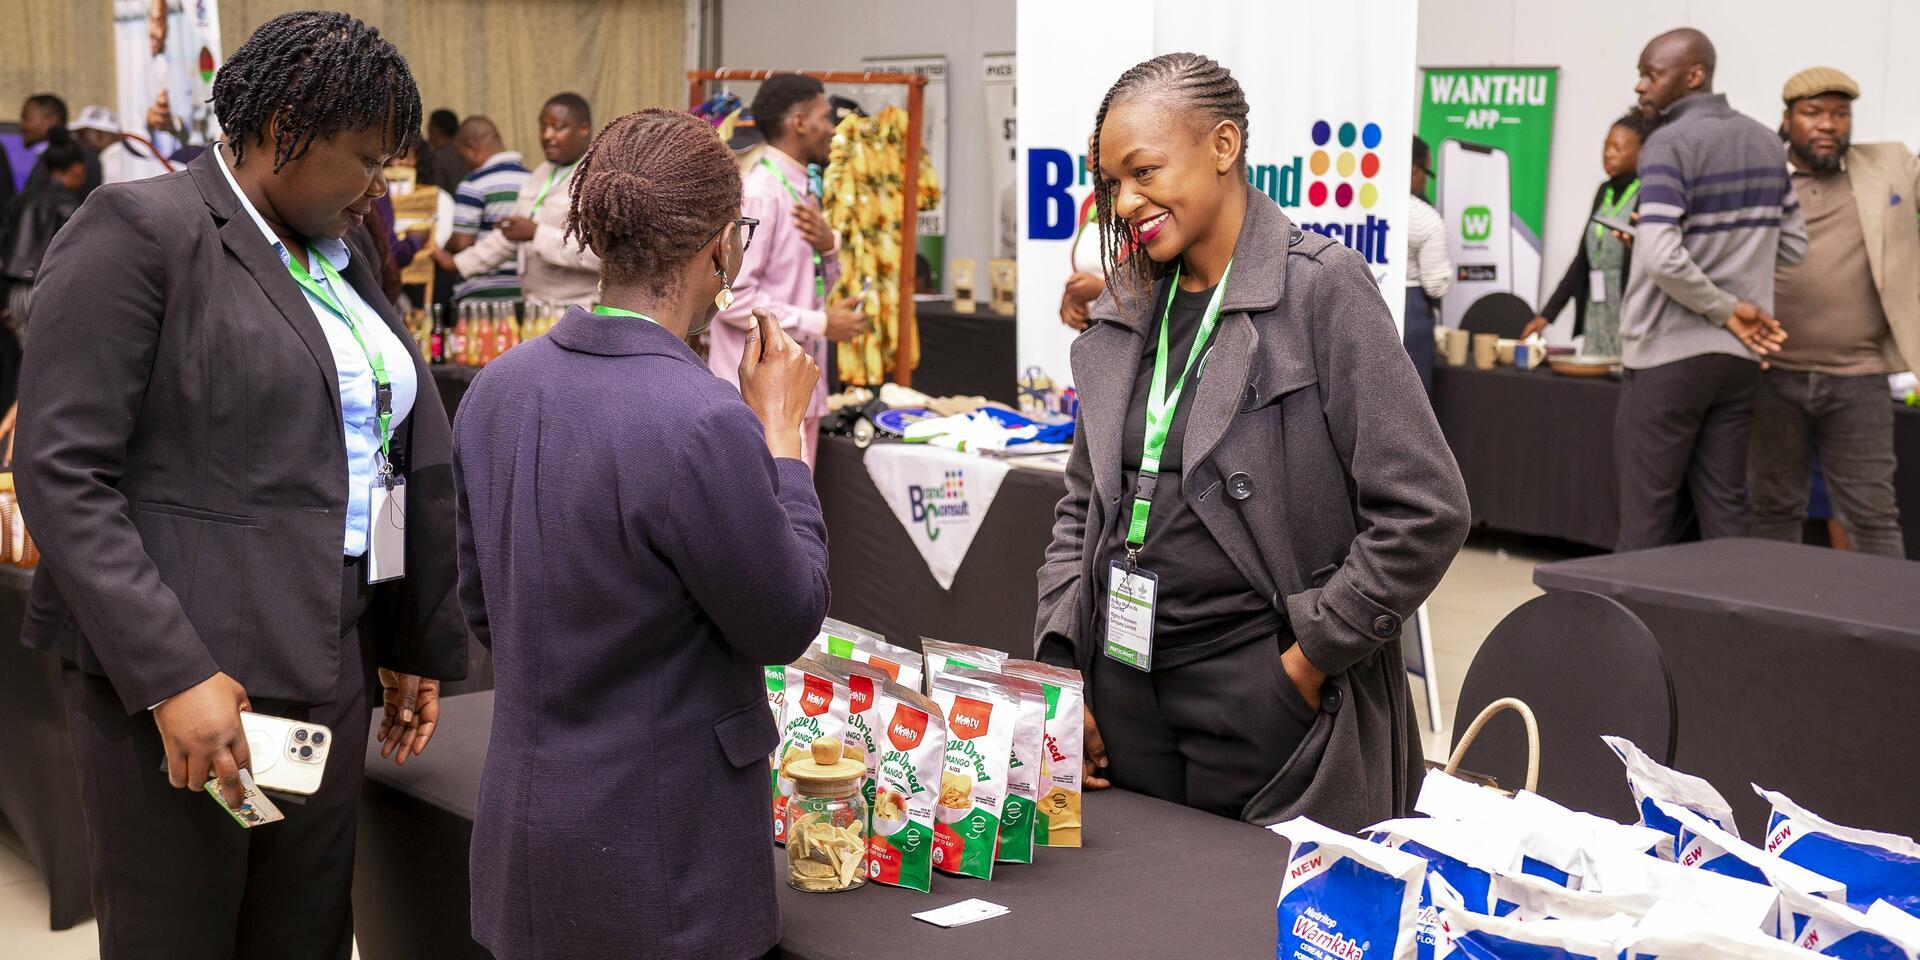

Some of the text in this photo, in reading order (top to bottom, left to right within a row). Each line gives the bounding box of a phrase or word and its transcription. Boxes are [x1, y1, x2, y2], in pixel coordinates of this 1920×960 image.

[1429, 75, 1548, 105] WANTHU
[1464, 109, 1500, 130] APP
[1464, 214, 1490, 236] W
[806, 691, 826, 708] Mighty
[850, 690, 866, 704] ghty
[784, 716, 809, 736] reeze
[808, 716, 825, 740] Dri
[893, 722, 918, 742] Mighty
[954, 713, 980, 730] Mighty
[792, 730, 813, 744] MANGO
[845, 731, 861, 741] NGO
[1043, 732, 1067, 764] ried
[945, 754, 971, 769] MANGO
[963, 739, 991, 783] Dried
[883, 765, 904, 780] MANGO
[899, 751, 926, 795] Dried
[1767, 826, 1792, 853] NEW
[1682, 846, 1703, 867] EW
[1291, 856, 1322, 879] NEW
[1303, 906, 1338, 929] Nutritop
[1416, 934, 1436, 946] FLOU
[1802, 929, 1819, 950] EW
